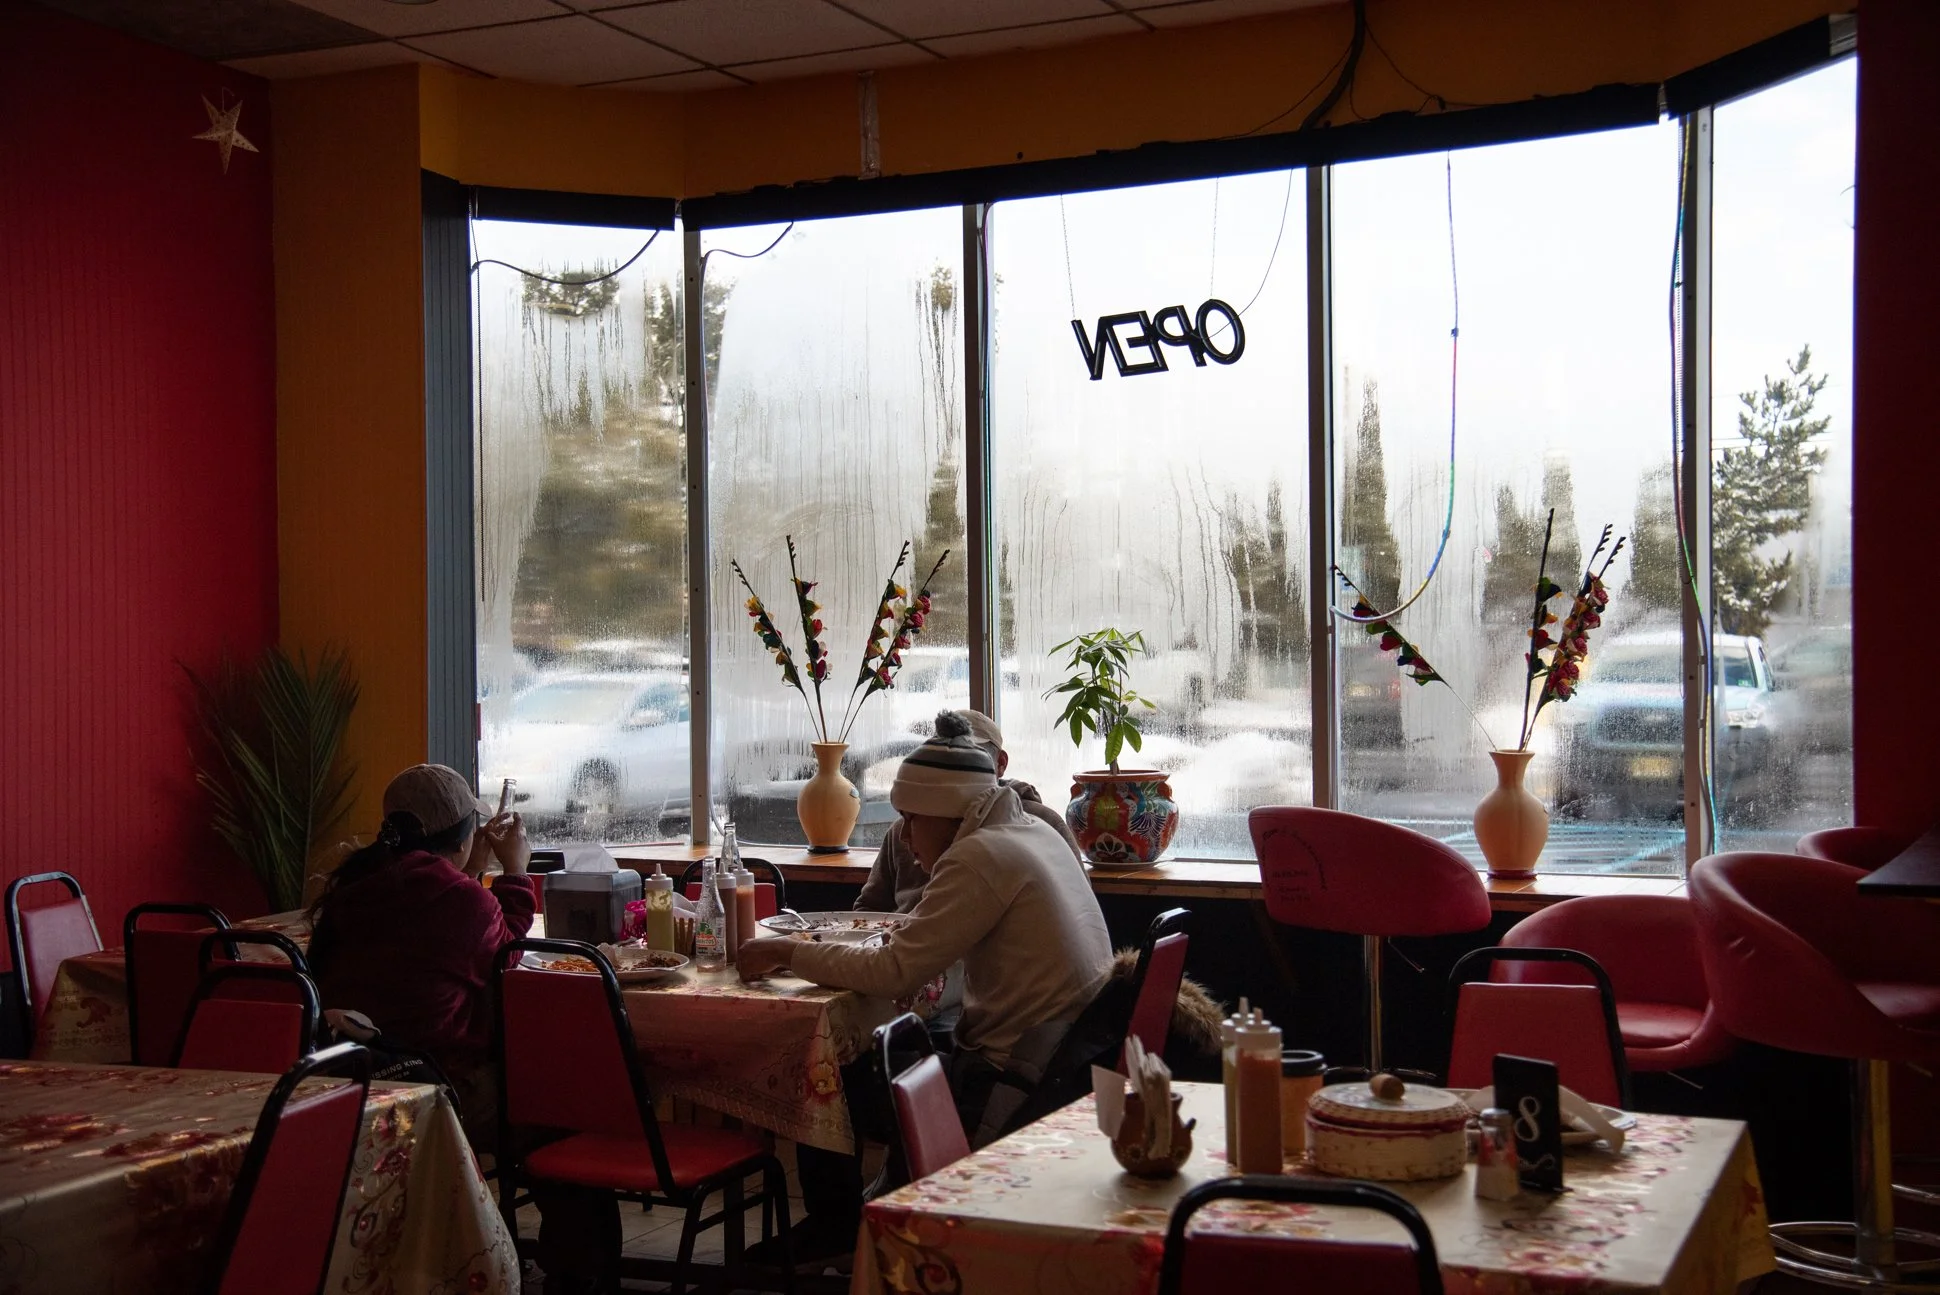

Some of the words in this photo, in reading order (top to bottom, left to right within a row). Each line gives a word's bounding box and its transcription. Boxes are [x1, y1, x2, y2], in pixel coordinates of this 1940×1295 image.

[371, 1063, 403, 1080] ISSING
[403, 1059, 424, 1068] KING
[1513, 1096, 1541, 1143] 8
